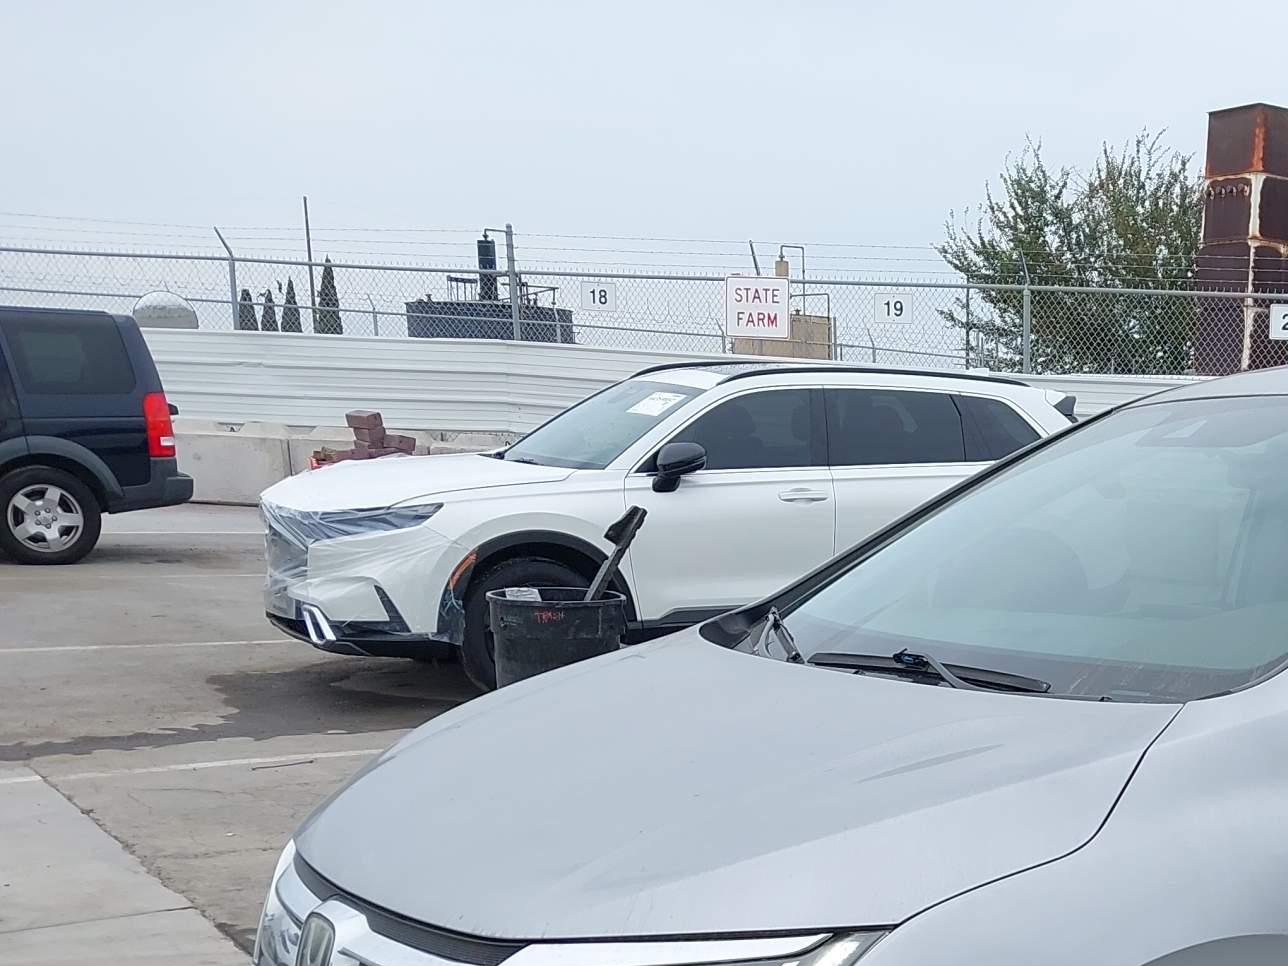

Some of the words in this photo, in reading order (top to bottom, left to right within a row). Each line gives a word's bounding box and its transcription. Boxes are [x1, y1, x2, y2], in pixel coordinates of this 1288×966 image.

[589, 288, 608, 305] 18
[734, 287, 781, 304] STATE
[883, 300, 904, 317] 19
[736, 311, 779, 328] FARM
